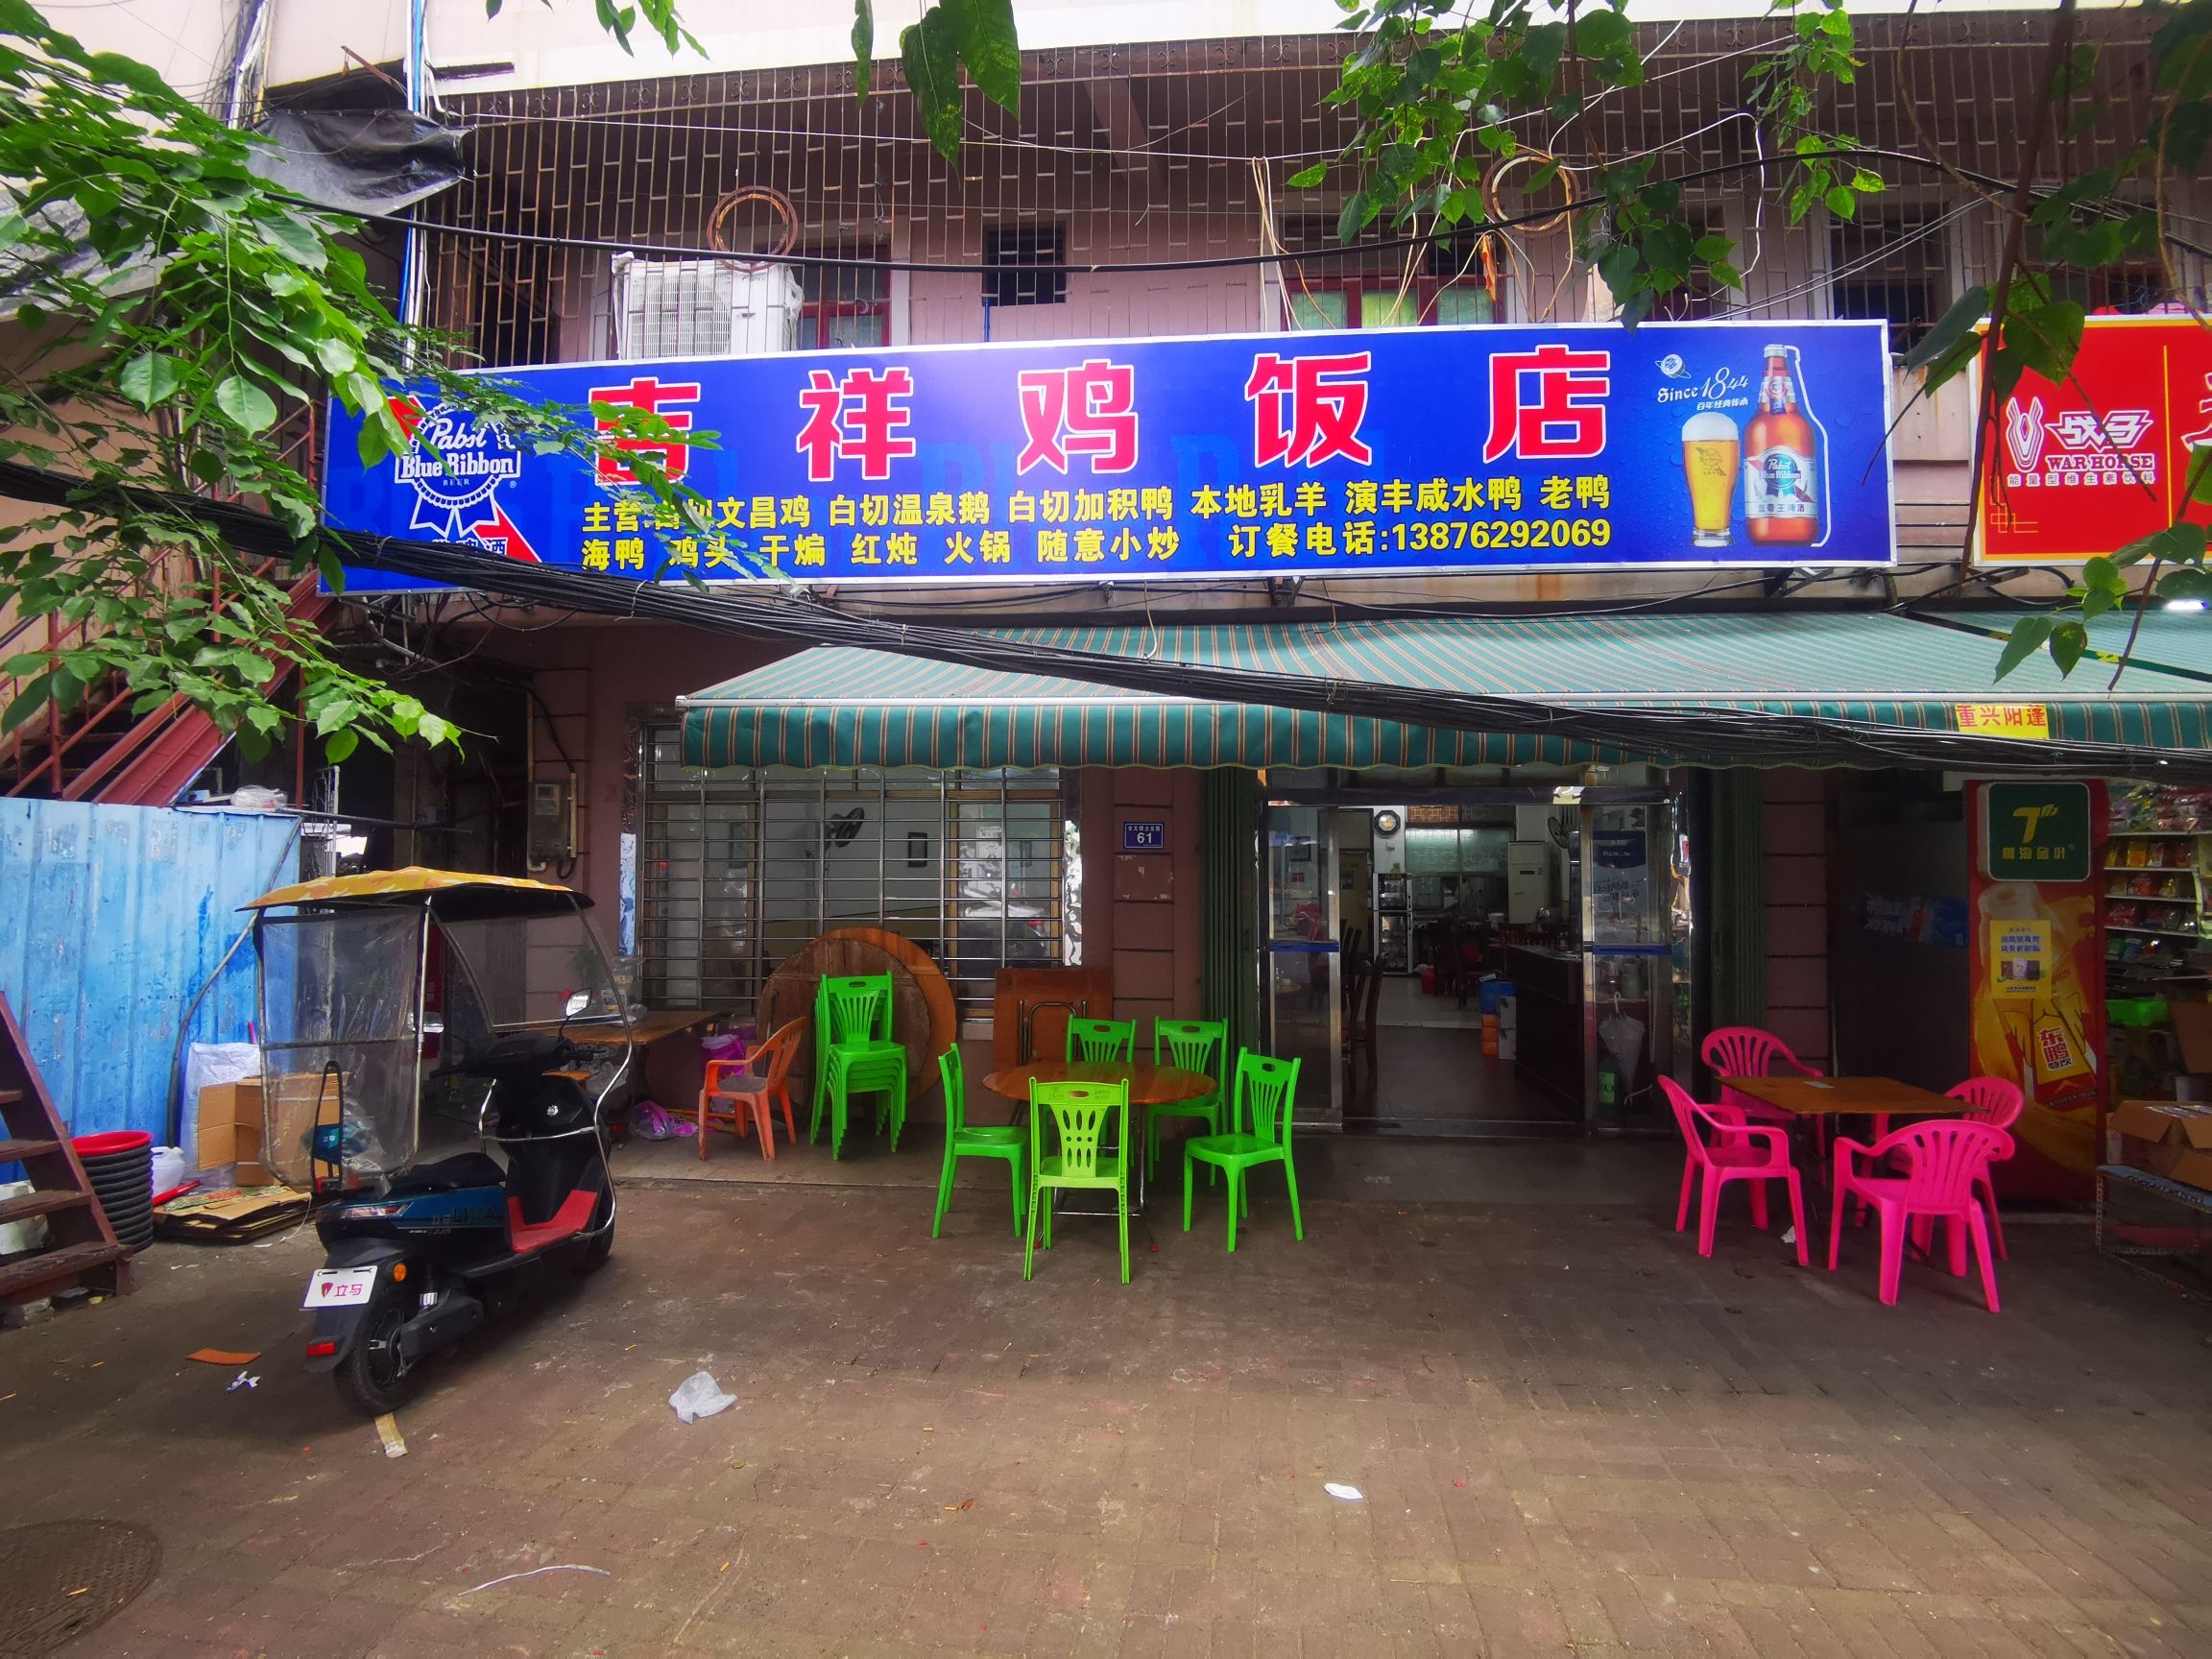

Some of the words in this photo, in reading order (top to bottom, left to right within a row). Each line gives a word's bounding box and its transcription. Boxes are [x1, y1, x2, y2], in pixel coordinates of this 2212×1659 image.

[1657, 387, 1698, 403] Since
[1700, 367, 1748, 399] 1844
[588, 344, 1611, 486] 吉祥鸡饭店
[429, 418, 491, 450] Pabst
[400, 454, 443, 478] Blue
[445, 451, 514, 476] Ribbon
[2047, 455, 2088, 470] WAR
[2090, 454, 2154, 470] HORSE
[2008, 473, 2154, 487] 能量型维生素饮料
[831, 491, 989, 526] 白切温泉鹅
[1009, 485, 1173, 523] 白切加积鸭
[1191, 481, 1328, 519] 本地乳羊
[1346, 476, 1522, 515] 演丰咸水鸭
[1540, 473, 1610, 510] 老鸭
[582, 537, 644, 571] 海鸭
[669, 535, 733, 569] 鸡头
[759, 534, 825, 566] 干煸
[851, 532, 918, 566] 红炖
[946, 530, 1011, 564] 火锅
[1038, 527, 1180, 563] 随意小炒
[1228, 518, 1611, 559] 订餐电话:13876292069
[1137, 831, 1152, 844] 61
[334, 1283, 363, 1296] 立马
